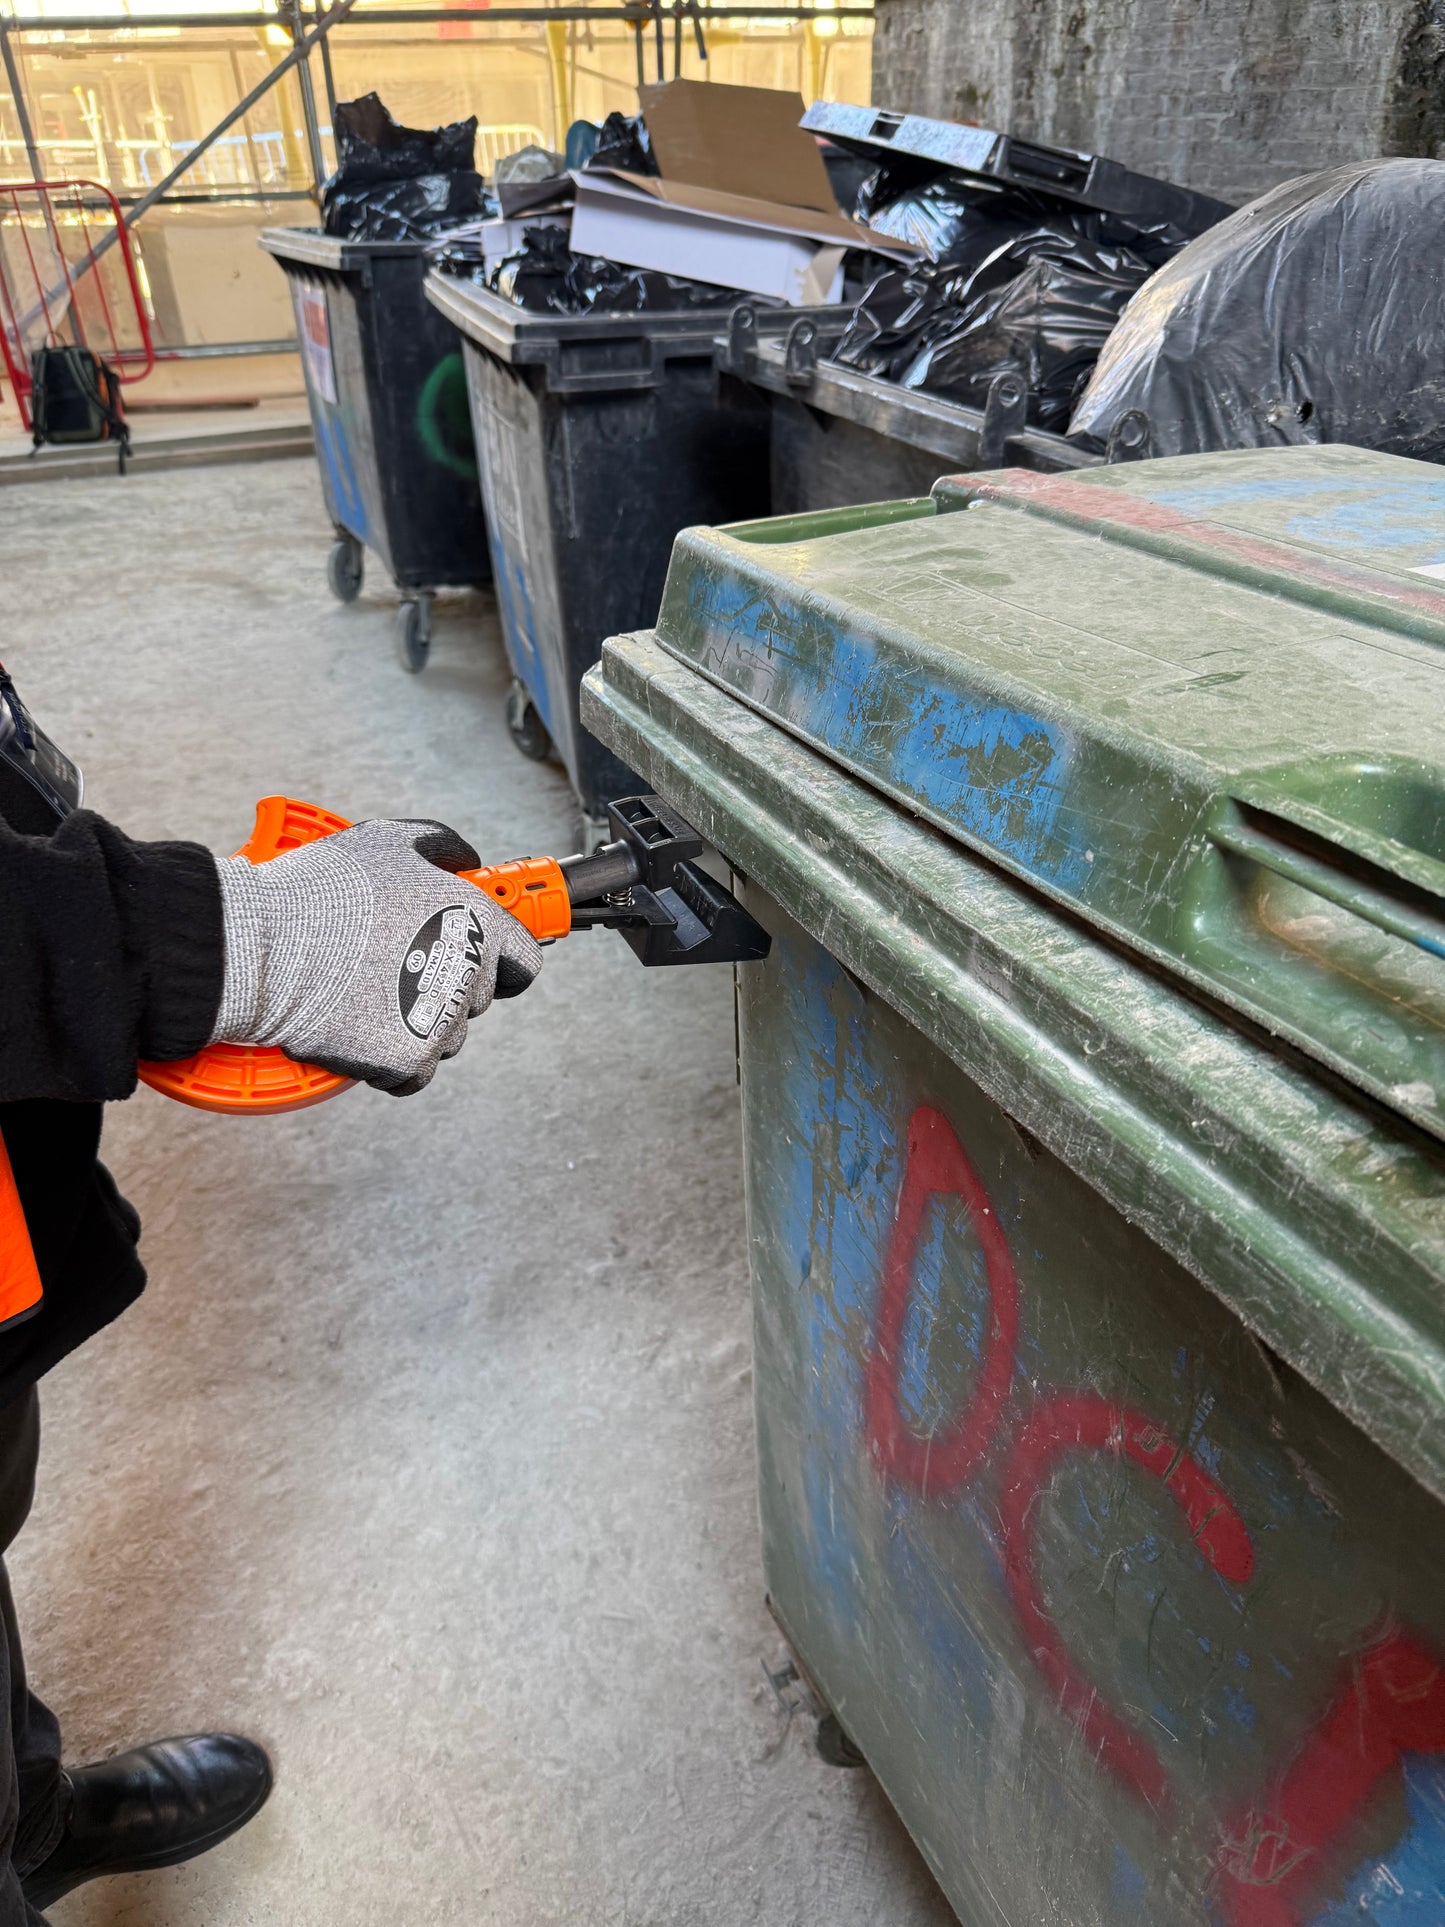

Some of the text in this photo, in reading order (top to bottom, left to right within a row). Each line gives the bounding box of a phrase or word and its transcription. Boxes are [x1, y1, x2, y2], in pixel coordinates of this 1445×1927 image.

[411, 953, 423, 968] 09
[422, 950, 442, 984] TM410
[430, 943, 456, 998] 4X42D
[434, 907, 484, 1038] Metric
